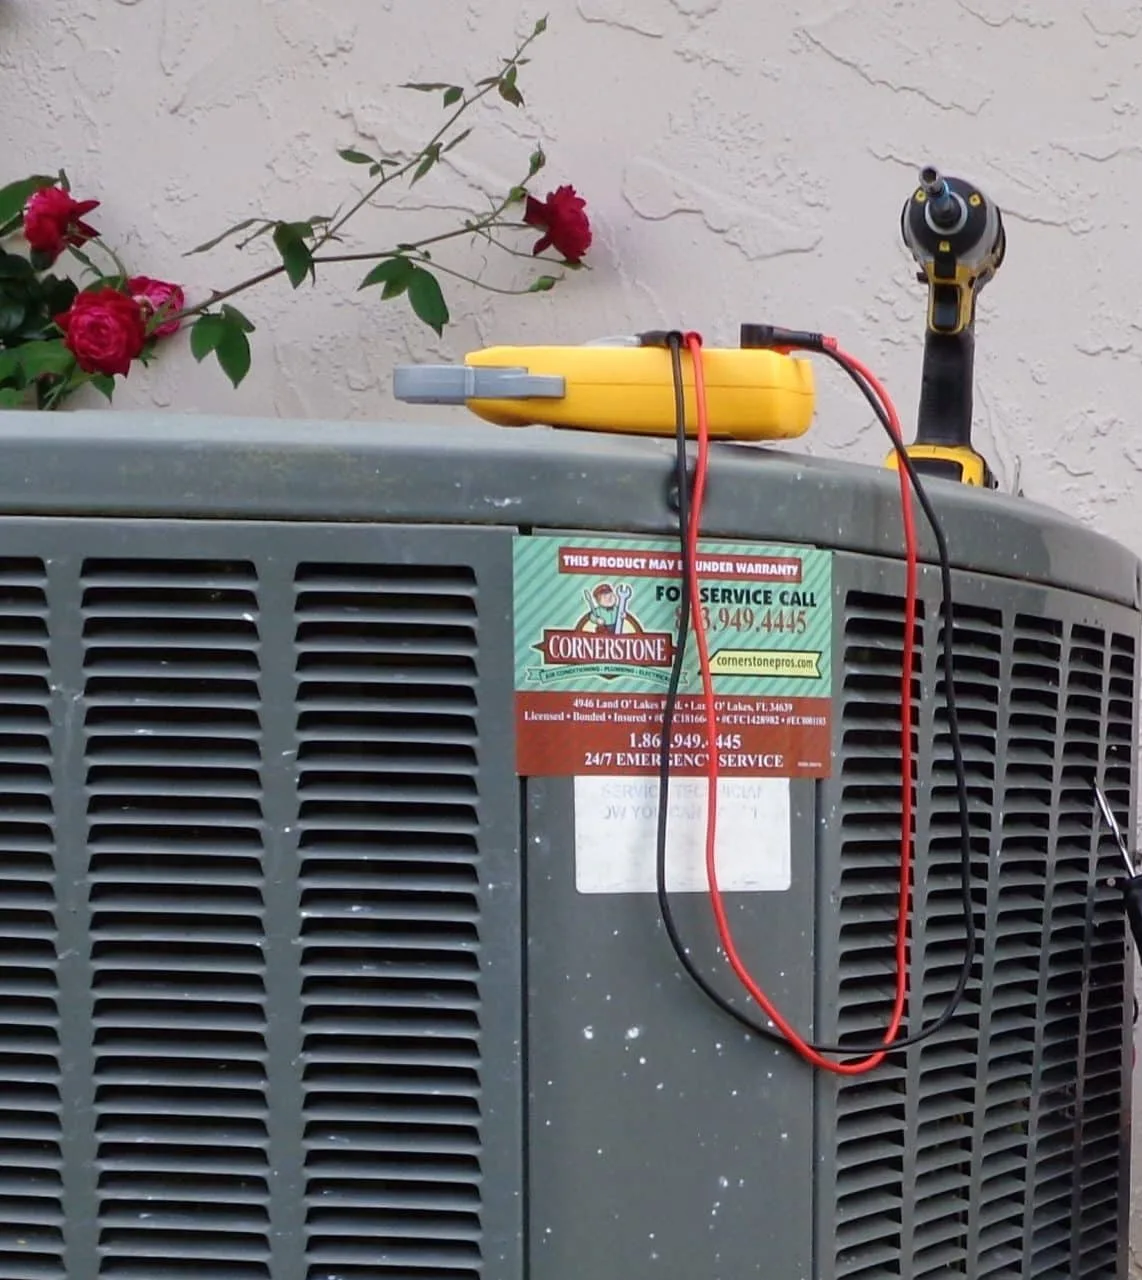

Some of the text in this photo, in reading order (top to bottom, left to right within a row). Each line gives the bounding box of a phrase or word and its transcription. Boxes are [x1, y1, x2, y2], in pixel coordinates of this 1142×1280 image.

[563, 556, 588, 567] THIS
[592, 557, 647, 569] PRODUCT
[650, 559, 672, 570] MAY
[696, 561, 732, 573] UNDER
[736, 563, 798, 575] WARRANTY
[656, 586, 816, 606] FO SERVICE CALL
[548, 635, 666, 661] CORNERSTONE
[717, 655, 813, 670] cornerstonepros.com
[573, 699, 593, 708] 4946
[596, 700, 618, 708] Land
[630, 733, 741, 749] 1.86.949.445
[585, 752, 612, 766] 24/7
[617, 753, 710, 767] EMERENC
[719, 754, 783, 768] SERVICE
